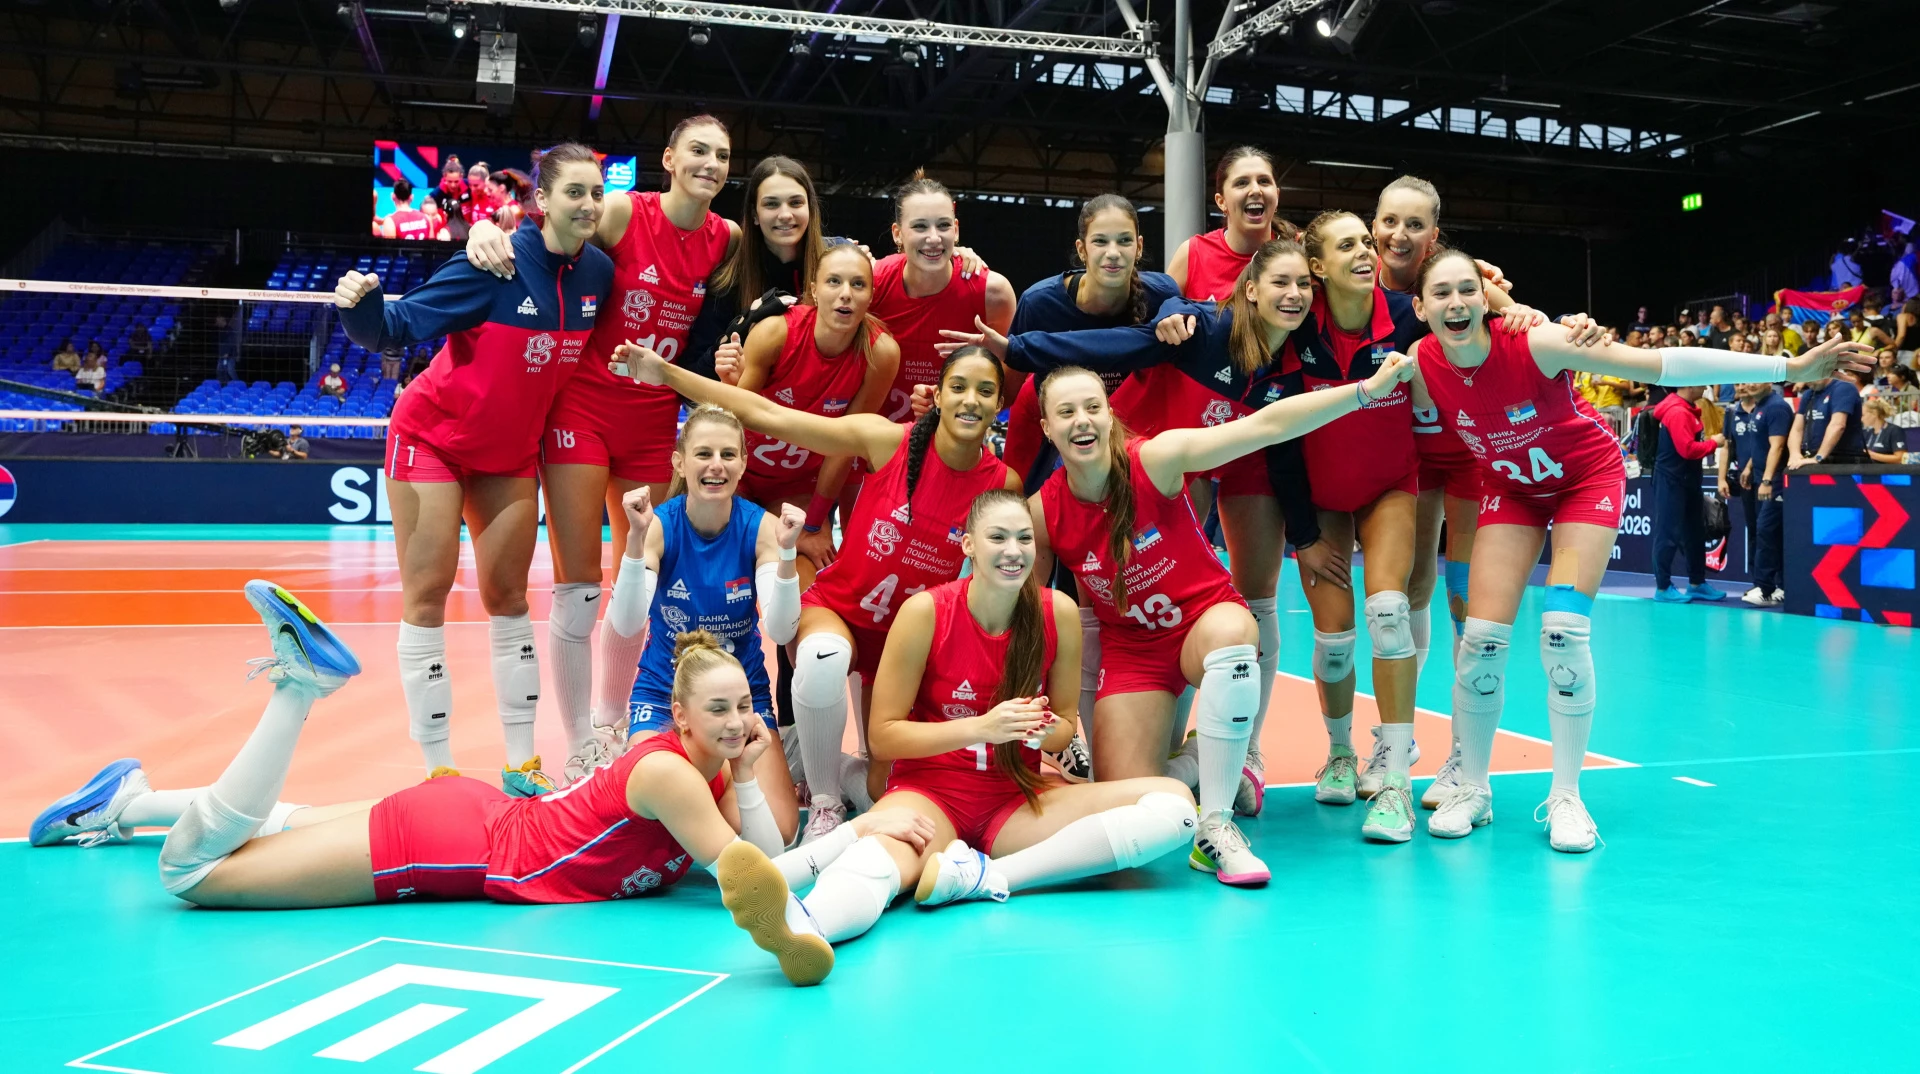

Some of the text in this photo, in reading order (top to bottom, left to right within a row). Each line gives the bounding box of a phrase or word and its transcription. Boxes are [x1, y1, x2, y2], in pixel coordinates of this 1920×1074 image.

[638, 273, 661, 285] PEAK
[517, 305, 539, 316] PEAK
[662, 300, 687, 311] БАНКА
[624, 321, 641, 331] 1921
[904, 360, 933, 368] БАНКА
[1213, 371, 1233, 385] PEAK
[775, 390, 796, 406] PEAK
[1456, 418, 1477, 427] PEAK
[552, 428, 576, 449] 18
[1486, 430, 1517, 440] БАНКА
[1491, 447, 1564, 497] 34
[1479, 495, 1501, 515] 34
[1594, 503, 1615, 513] PEAK
[910, 538, 939, 554] БАНКА
[865, 549, 883, 563] 1921
[1082, 561, 1102, 572] PEAK
[1124, 556, 1169, 586] ОШТАНСКА
[666, 589, 691, 601] PEAK
[1124, 593, 1183, 631] 13
[698, 614, 730, 623] БАНКА
[951, 690, 978, 701] PEAK
